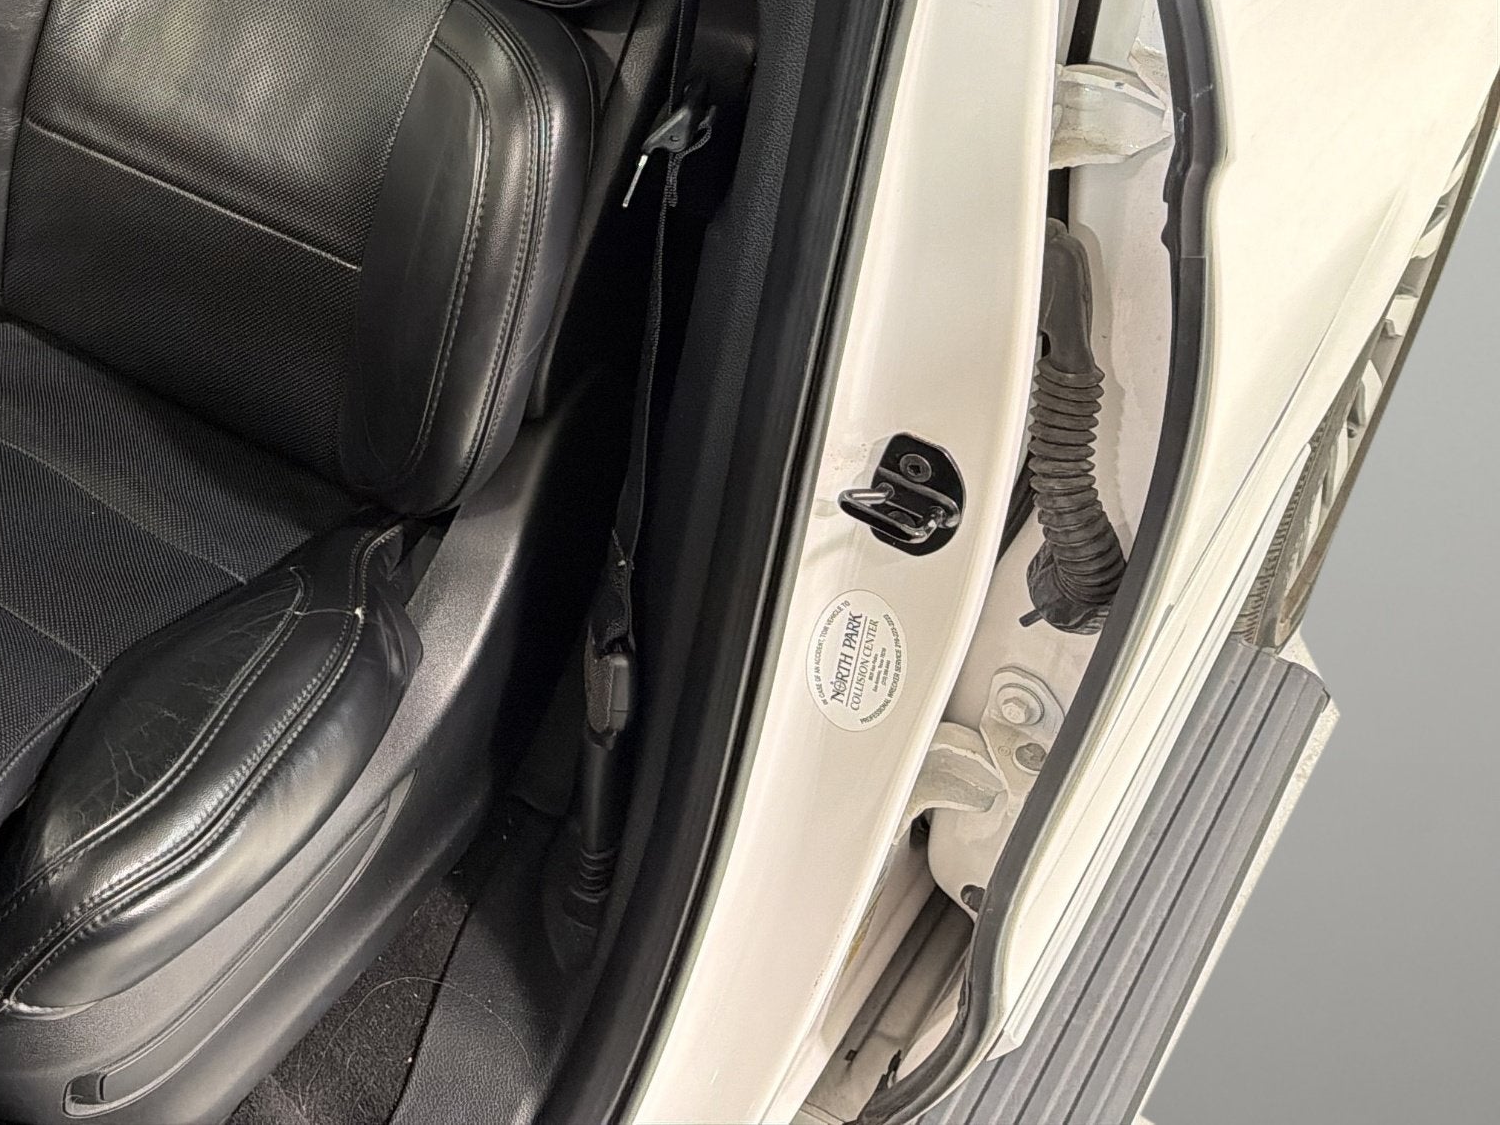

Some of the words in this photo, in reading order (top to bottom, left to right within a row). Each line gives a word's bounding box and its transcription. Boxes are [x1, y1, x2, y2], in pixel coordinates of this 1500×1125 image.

[840, 600, 851, 608] TO
[841, 610, 863, 651] PARK
[814, 666, 820, 674] AN
[830, 651, 854, 704] NORTH
[850, 657, 870, 711] COLLISION
[862, 619, 879, 657] CENTER
[815, 683, 826, 698] CASE
